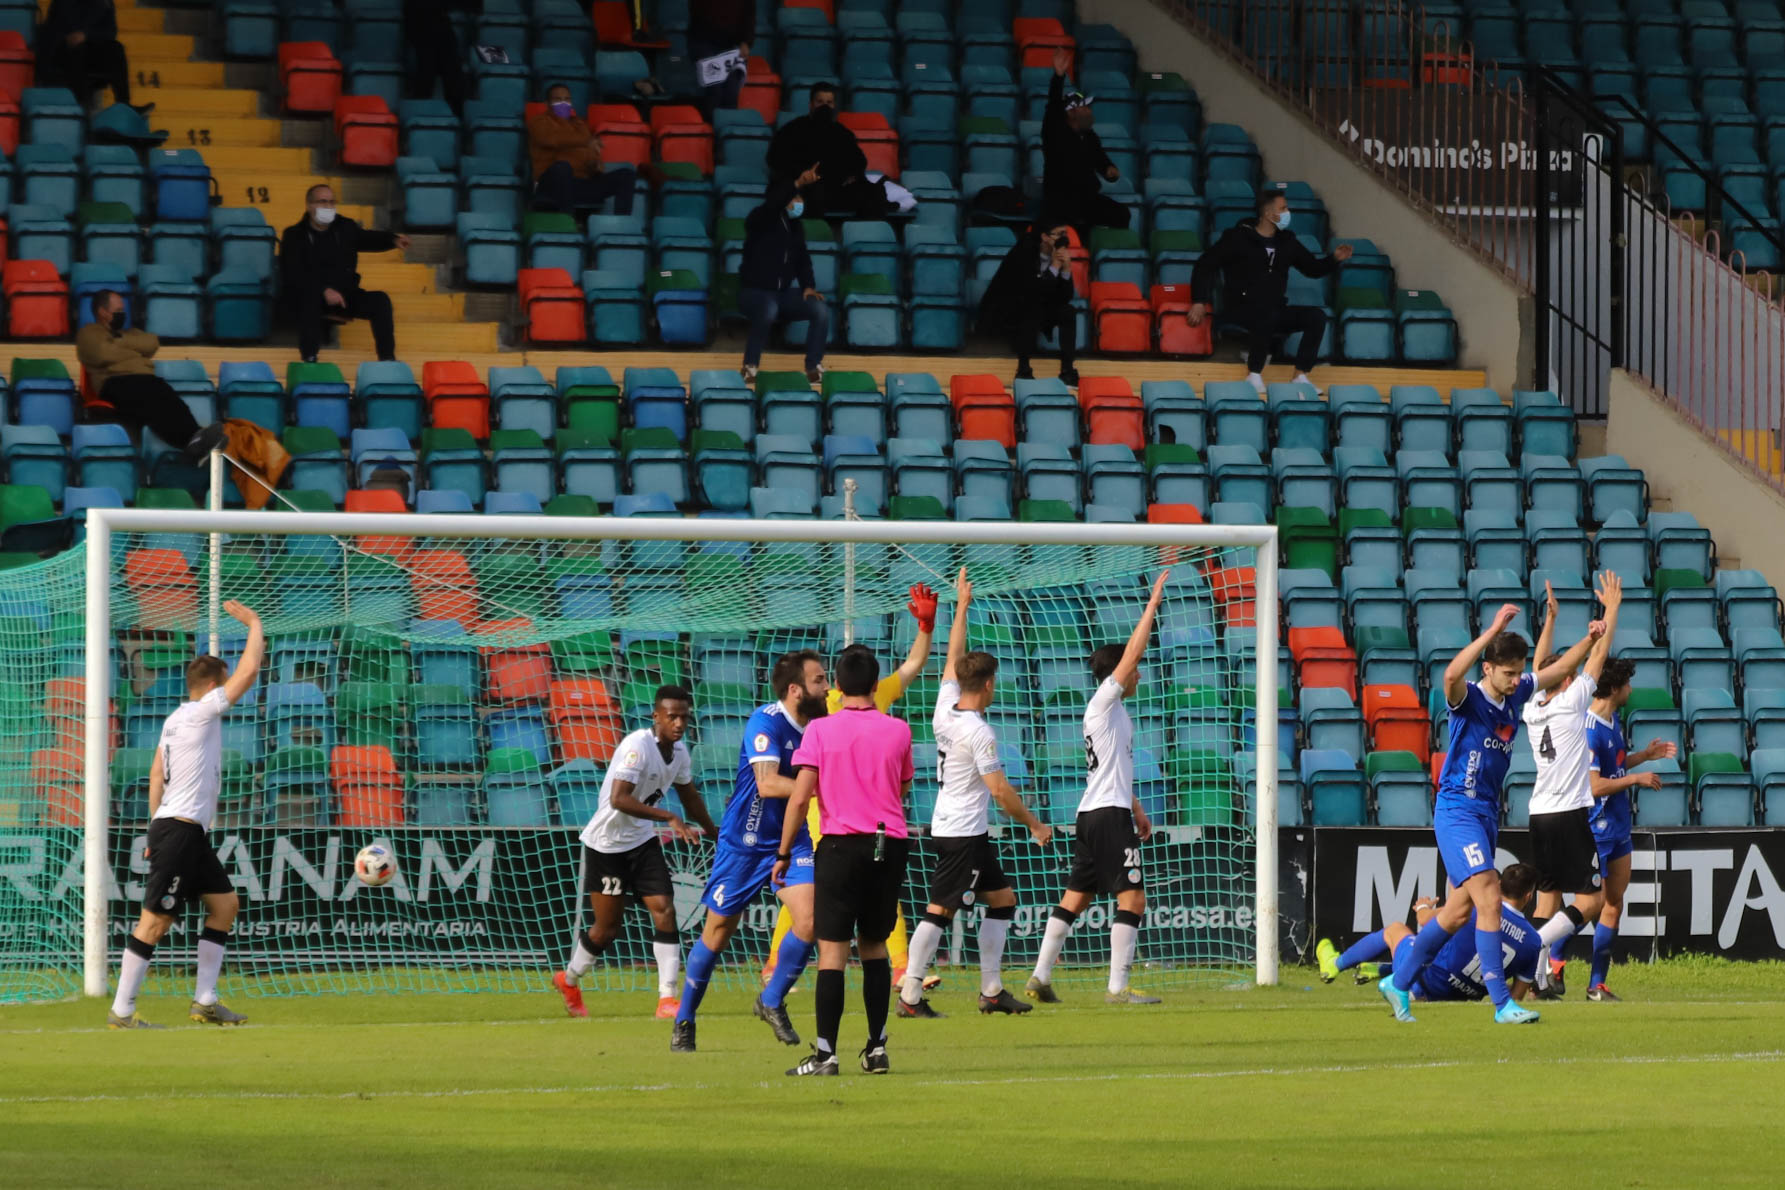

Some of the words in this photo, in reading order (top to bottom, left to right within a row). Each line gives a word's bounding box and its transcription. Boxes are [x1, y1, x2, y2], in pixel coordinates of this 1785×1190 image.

[136, 71, 160, 88] 14
[187, 129, 211, 146] 13
[1364, 138, 1493, 170] Domino's
[246, 187, 270, 204] 12
[1539, 725, 1557, 764] 4
[1123, 847, 1141, 867] 28
[1463, 842, 1485, 868] 15
[1591, 852, 1599, 870] 4
[168, 876, 180, 894] 3
[601, 876, 623, 896] 22
[969, 869, 980, 889] 7
[713, 883, 726, 907] 4
[1352, 843, 1785, 950] META
[197, 917, 321, 937] IUSTRIA
[330, 919, 489, 937] ALIMENTARIA
